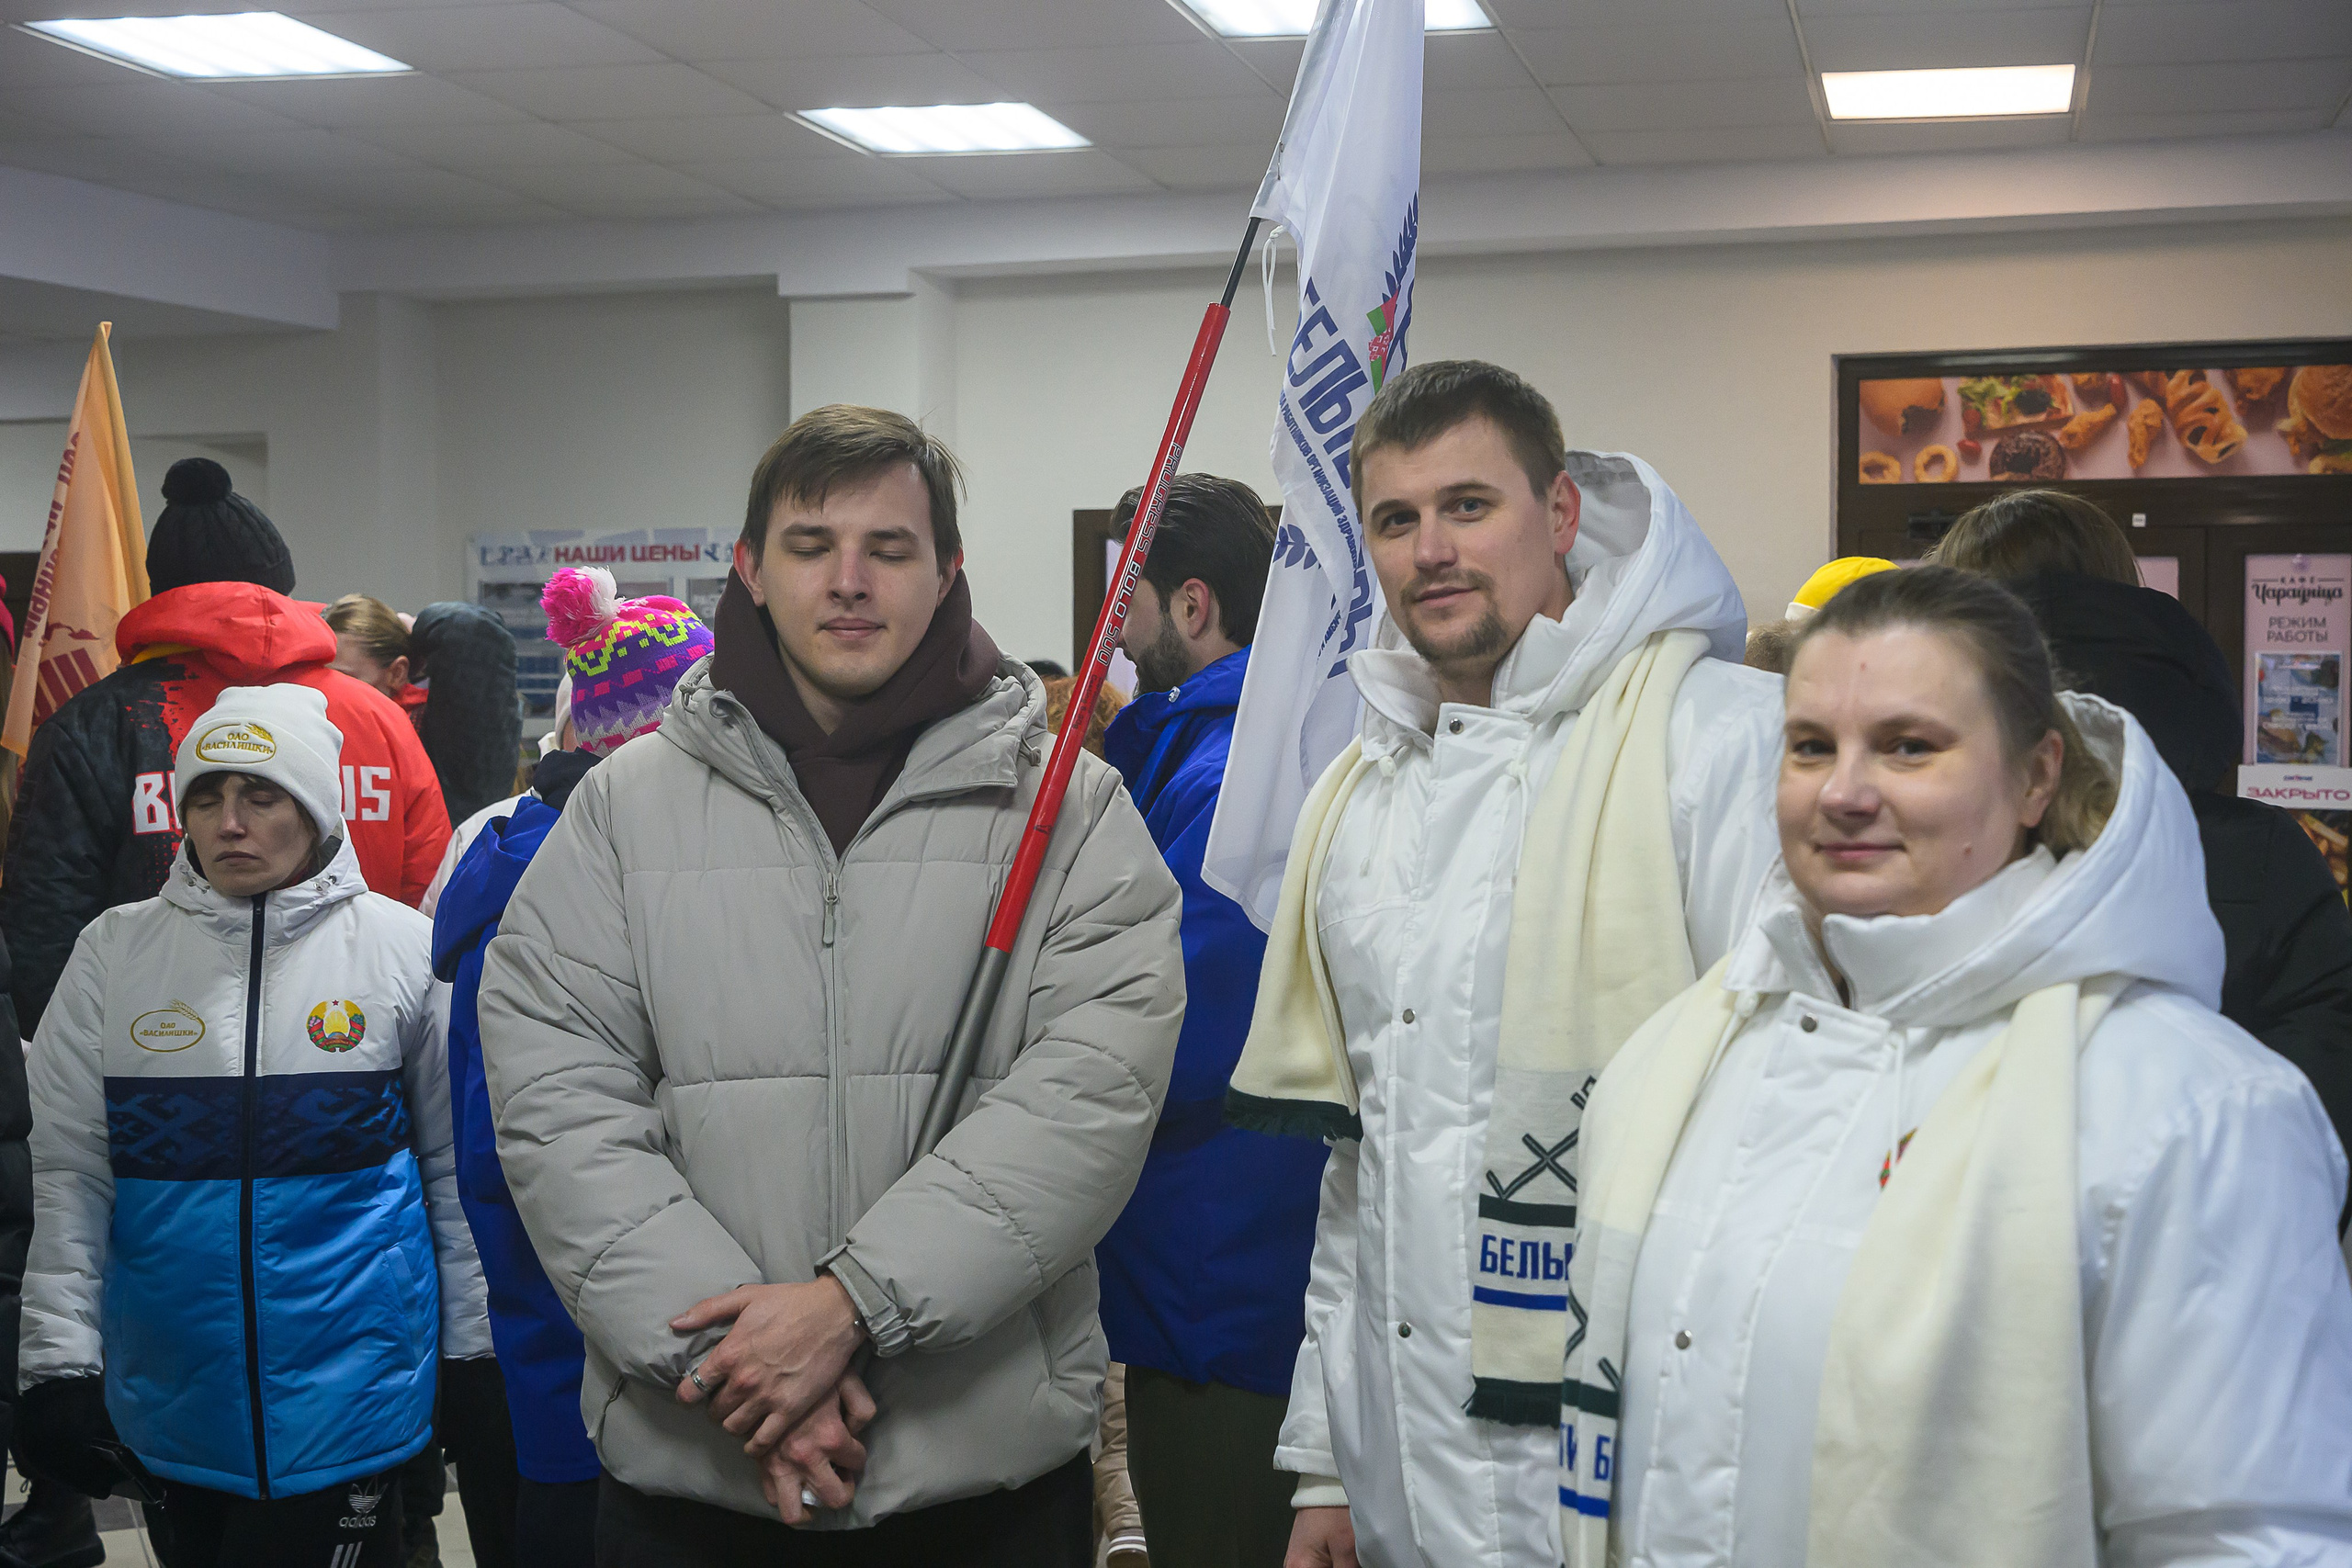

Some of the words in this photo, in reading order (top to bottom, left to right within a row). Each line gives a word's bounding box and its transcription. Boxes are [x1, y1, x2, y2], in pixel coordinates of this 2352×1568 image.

[1136, 442, 1182, 554] PROGRESS
[554, 545, 625, 564] НАШИ
[631, 543, 701, 563] ЦЕНЫ
[1114, 560, 1141, 619] BOLO
[2268, 616, 2327, 628] РЕЖИМ
[2267, 629, 2328, 643] РАБОТЫ
[1097, 624, 1121, 667] 500
[2247, 786, 2350, 801] ЗАКРЫТО
[339, 1515, 377, 1529] adidas
